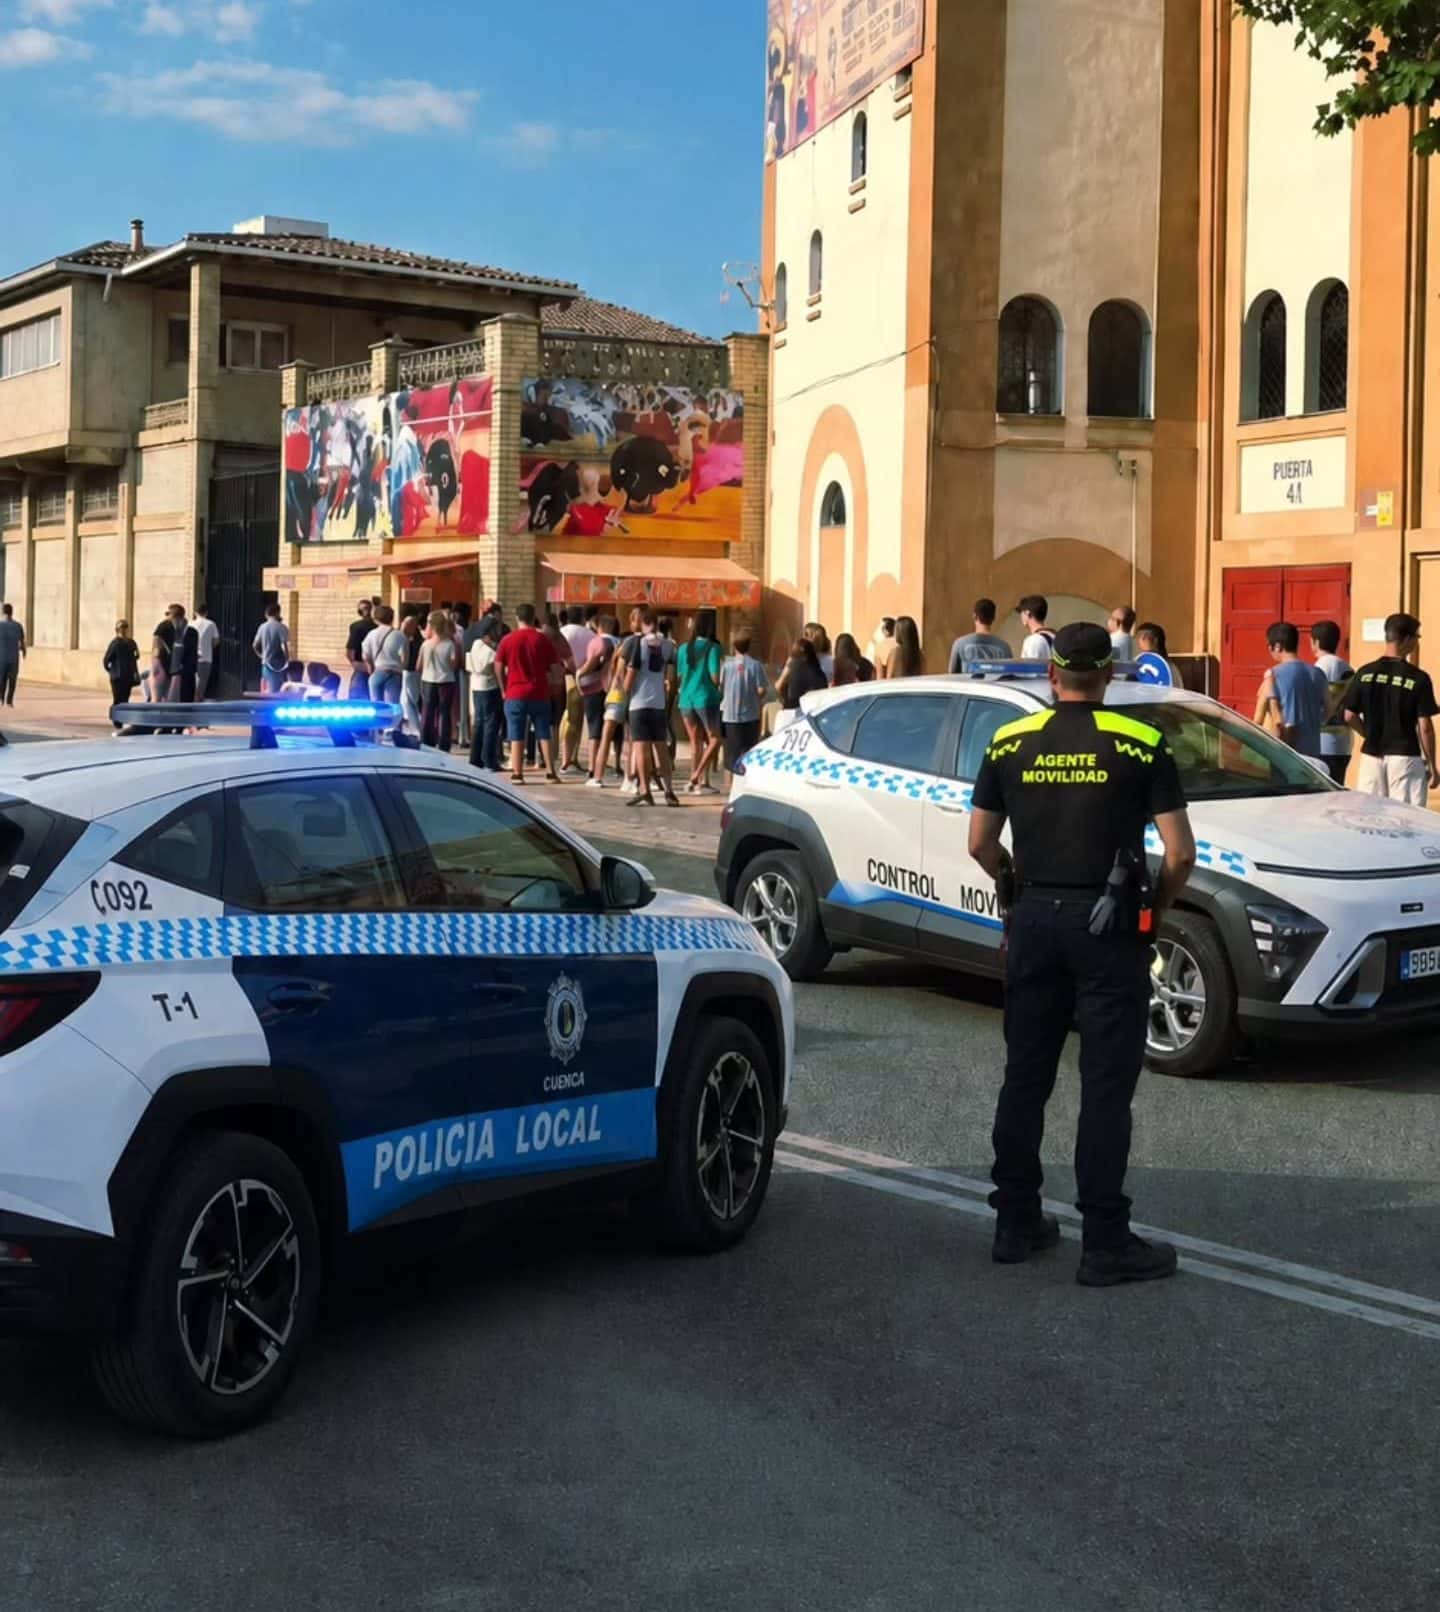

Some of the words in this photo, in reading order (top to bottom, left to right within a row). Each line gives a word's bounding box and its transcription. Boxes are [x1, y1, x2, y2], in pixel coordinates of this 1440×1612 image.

[1273, 459, 1313, 480] PUERTA
[1034, 753, 1097, 767] AGENTE
[1022, 770, 1109, 783] MOVILIDAD
[867, 858, 940, 901] CONTROL
[152, 991, 199, 1022] T-1
[543, 1071, 585, 1092] CUENCA
[373, 1118, 495, 1189] POLICIA
[516, 1104, 602, 1154] LOCAL
